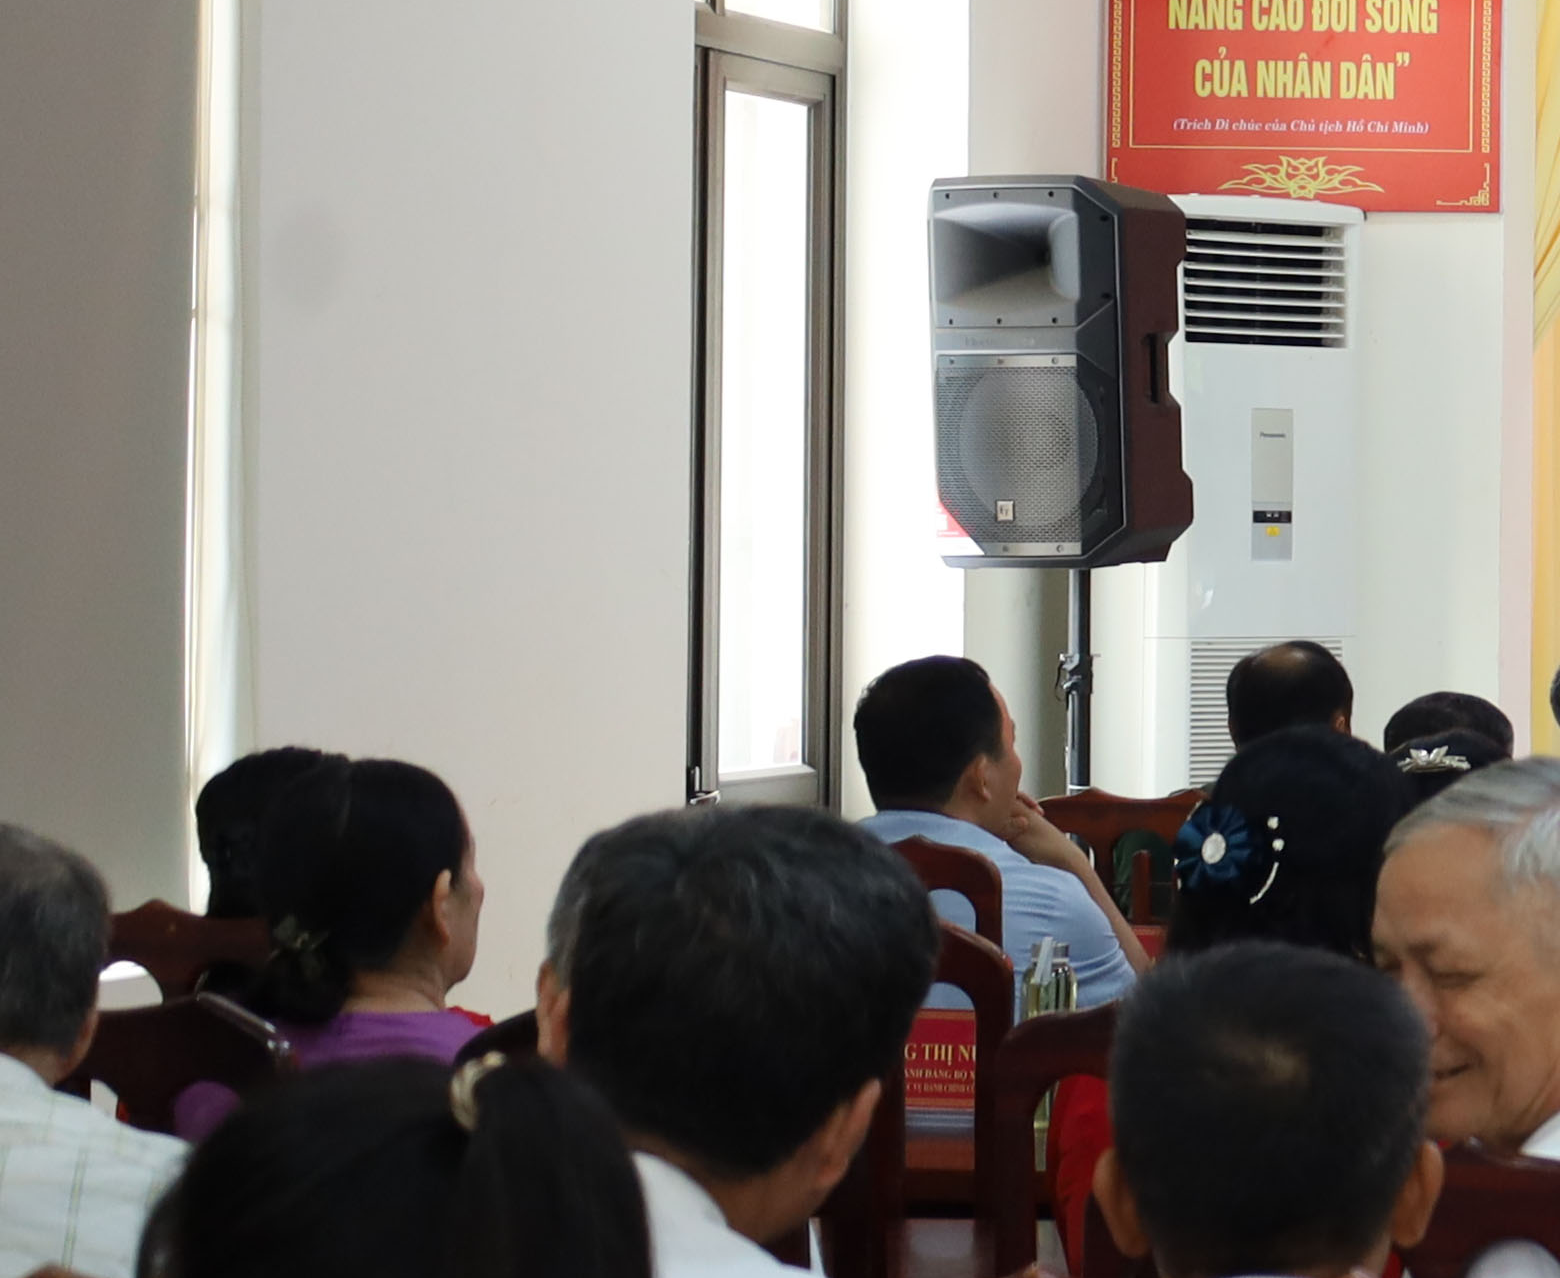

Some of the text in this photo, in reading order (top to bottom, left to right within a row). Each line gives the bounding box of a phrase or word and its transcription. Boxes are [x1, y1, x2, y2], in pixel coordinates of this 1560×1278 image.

[1195, 47, 1411, 101] CỦA NHÂN DÂN”
